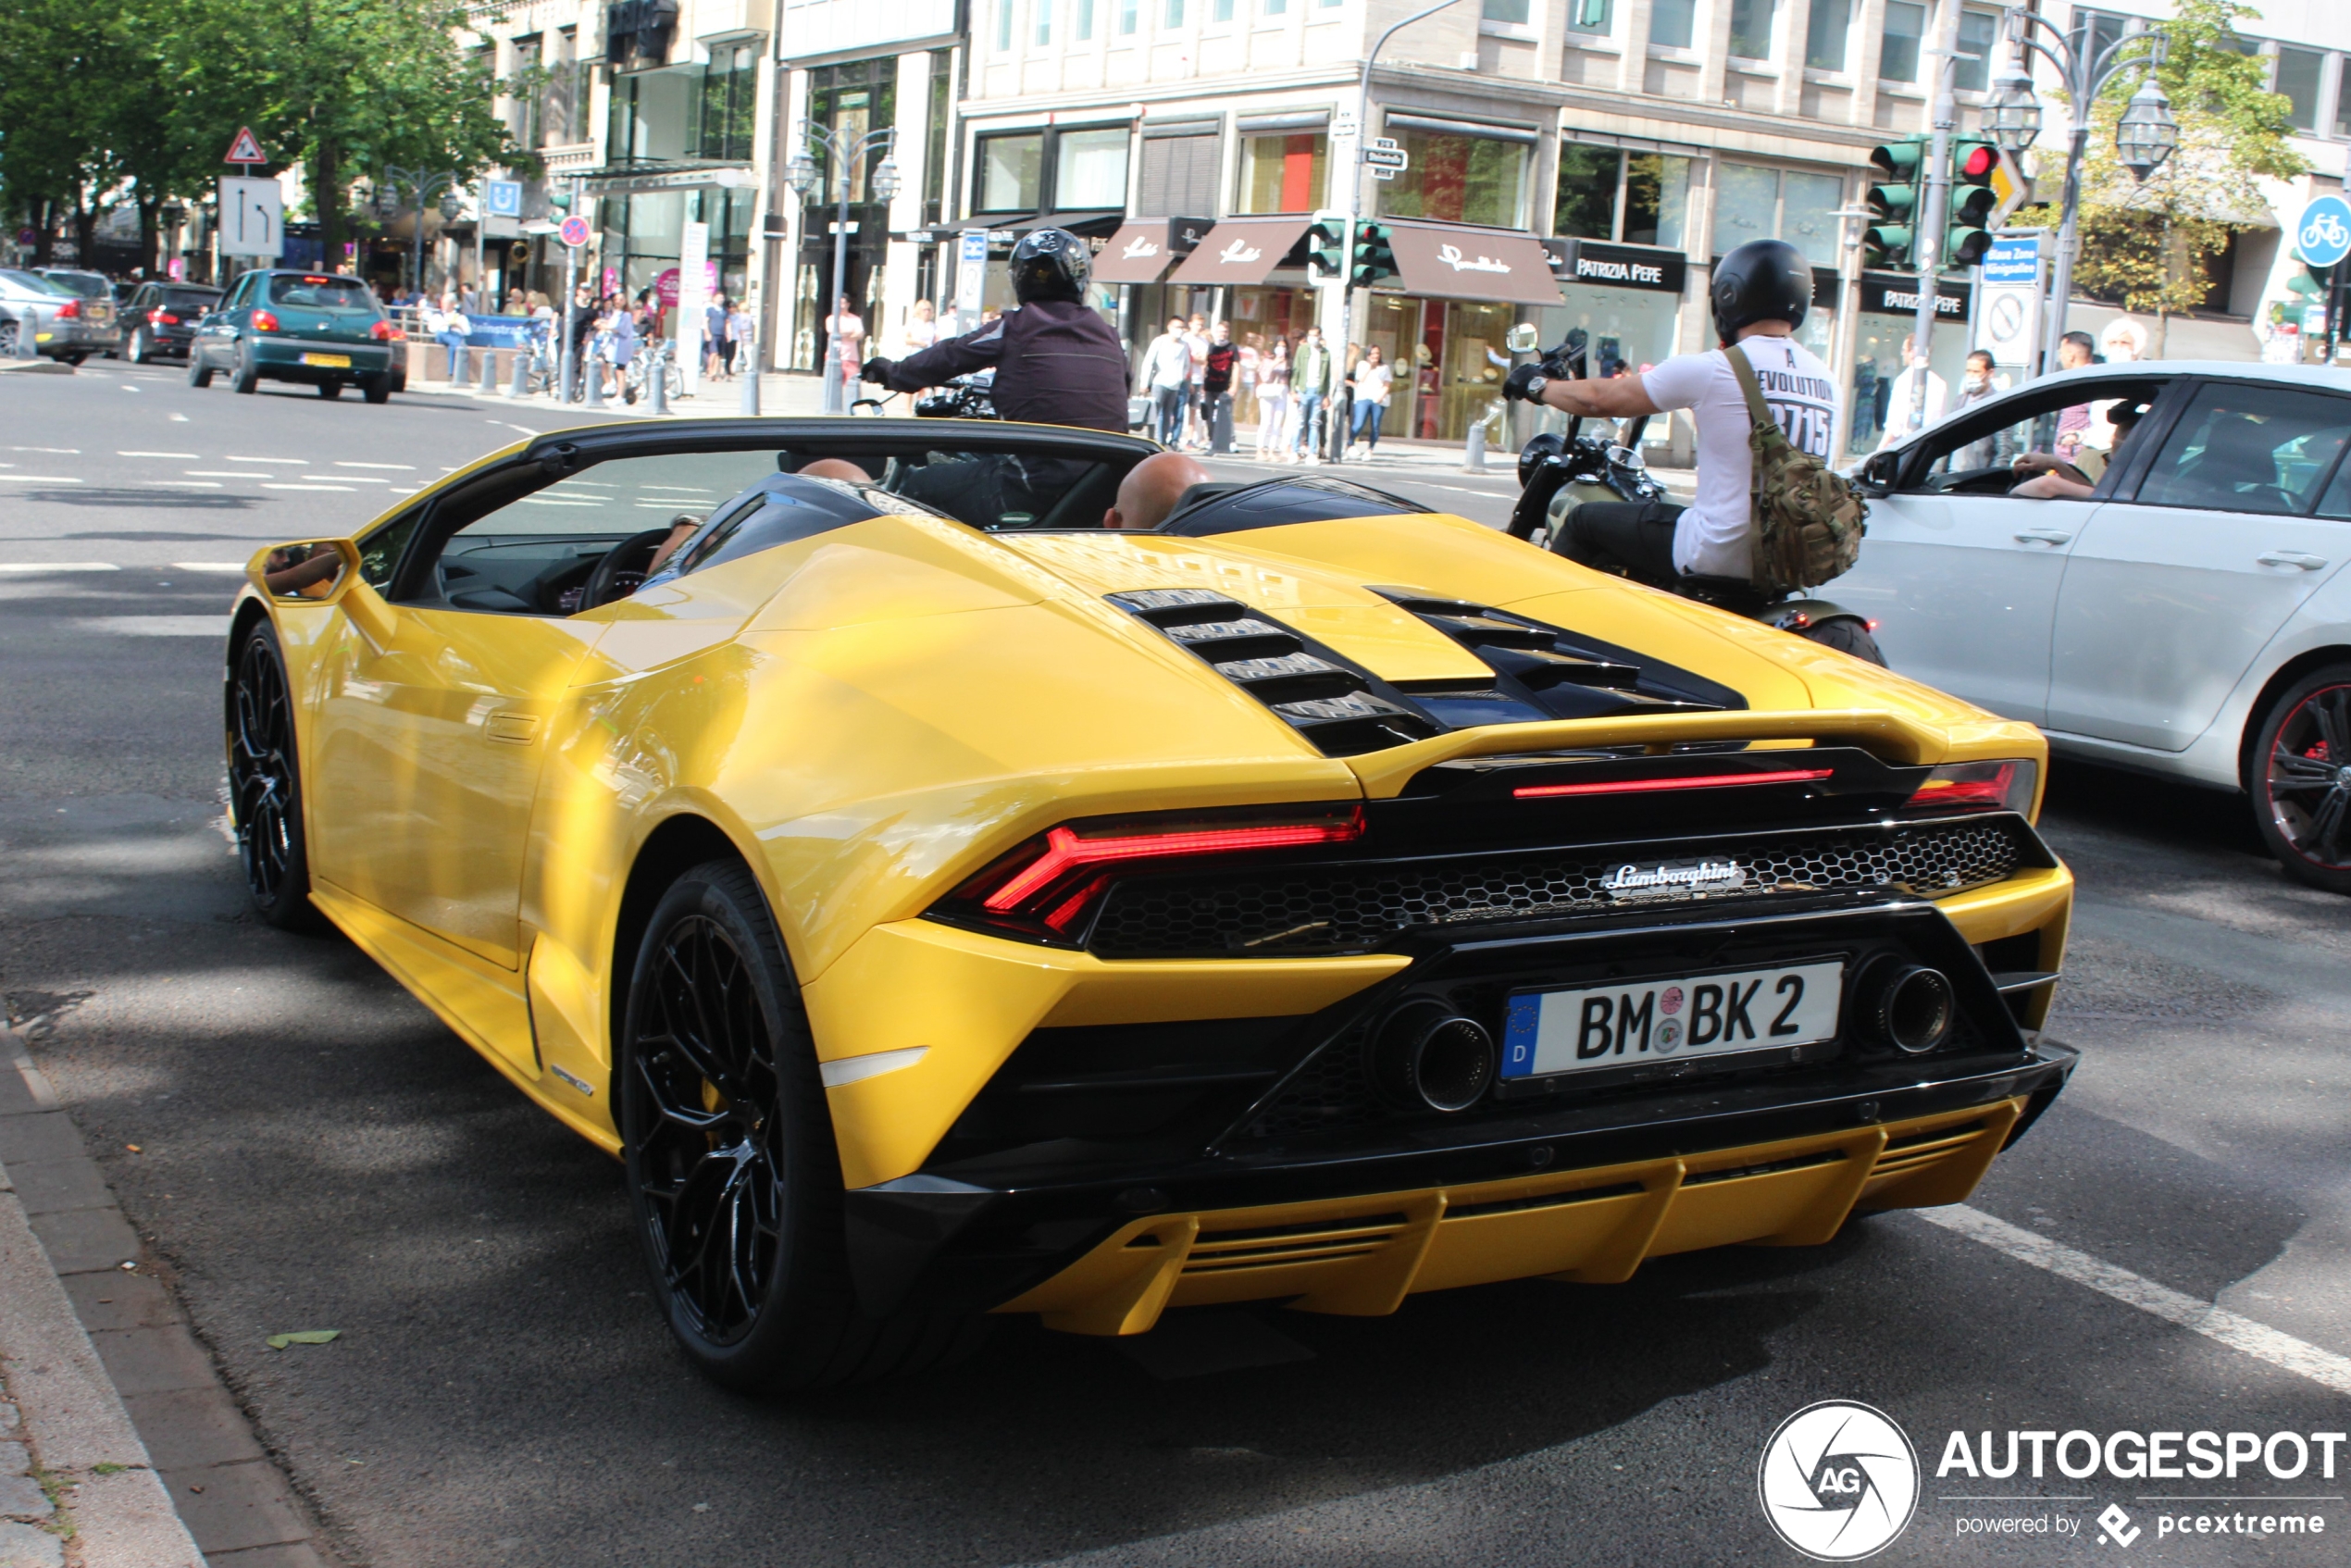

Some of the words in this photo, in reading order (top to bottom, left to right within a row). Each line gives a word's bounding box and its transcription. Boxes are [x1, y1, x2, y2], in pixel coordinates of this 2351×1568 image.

[2013, 247, 2036, 260] Zone
[1576, 257, 1630, 280] PATRIZIA
[1630, 263, 1662, 283] PEPE
[1934, 294, 1961, 313] PEPE
[1785, 348, 1797, 368] A
[1754, 369, 1834, 403] EVOLUTION
[1605, 860, 1739, 890] Lamborghini
[1577, 990, 1655, 1060] BM
[1687, 978, 1763, 1046] BK
[1769, 974, 1804, 1037] 2
[1512, 1045, 1526, 1063] D
